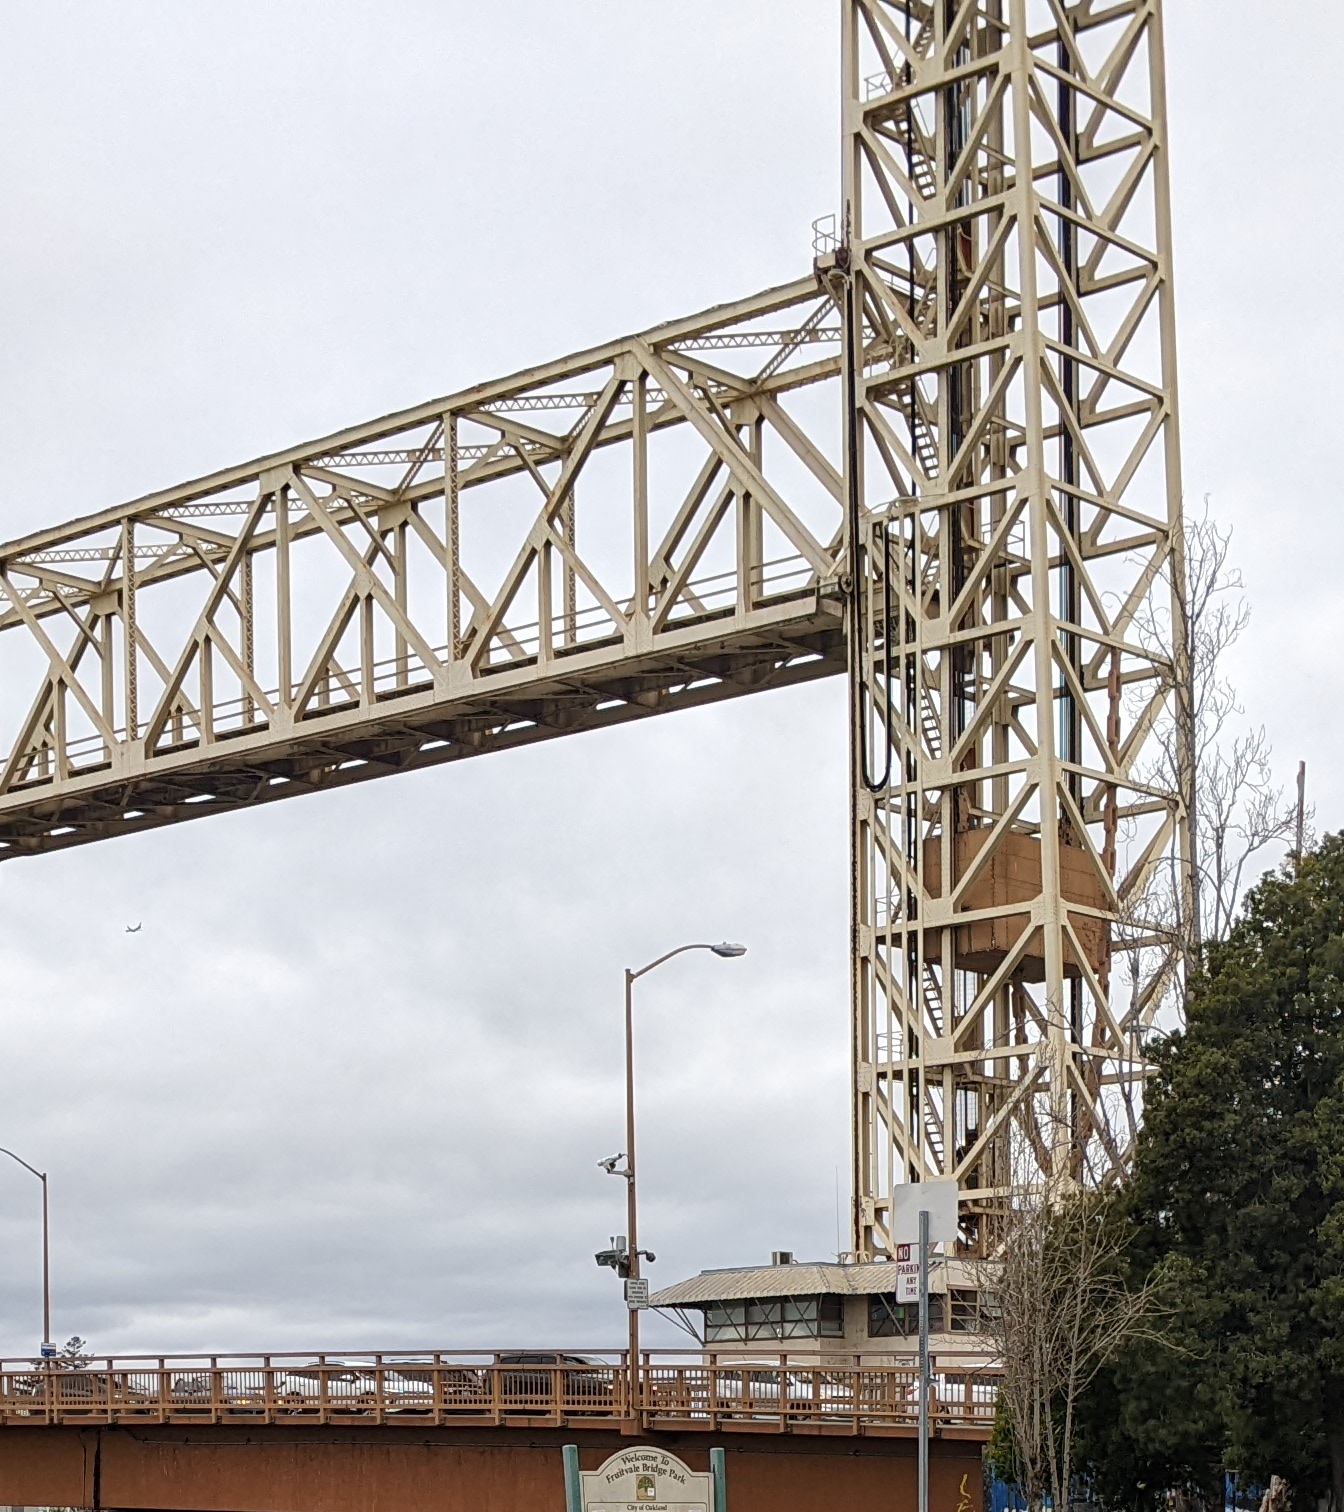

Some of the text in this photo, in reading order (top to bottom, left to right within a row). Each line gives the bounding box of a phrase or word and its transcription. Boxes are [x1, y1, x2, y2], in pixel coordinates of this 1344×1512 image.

[898, 1246, 908, 1259] NO
[621, 1453, 670, 1466] Welcome To
[605, 1463, 686, 1484] Fruitvale Bridge Park
